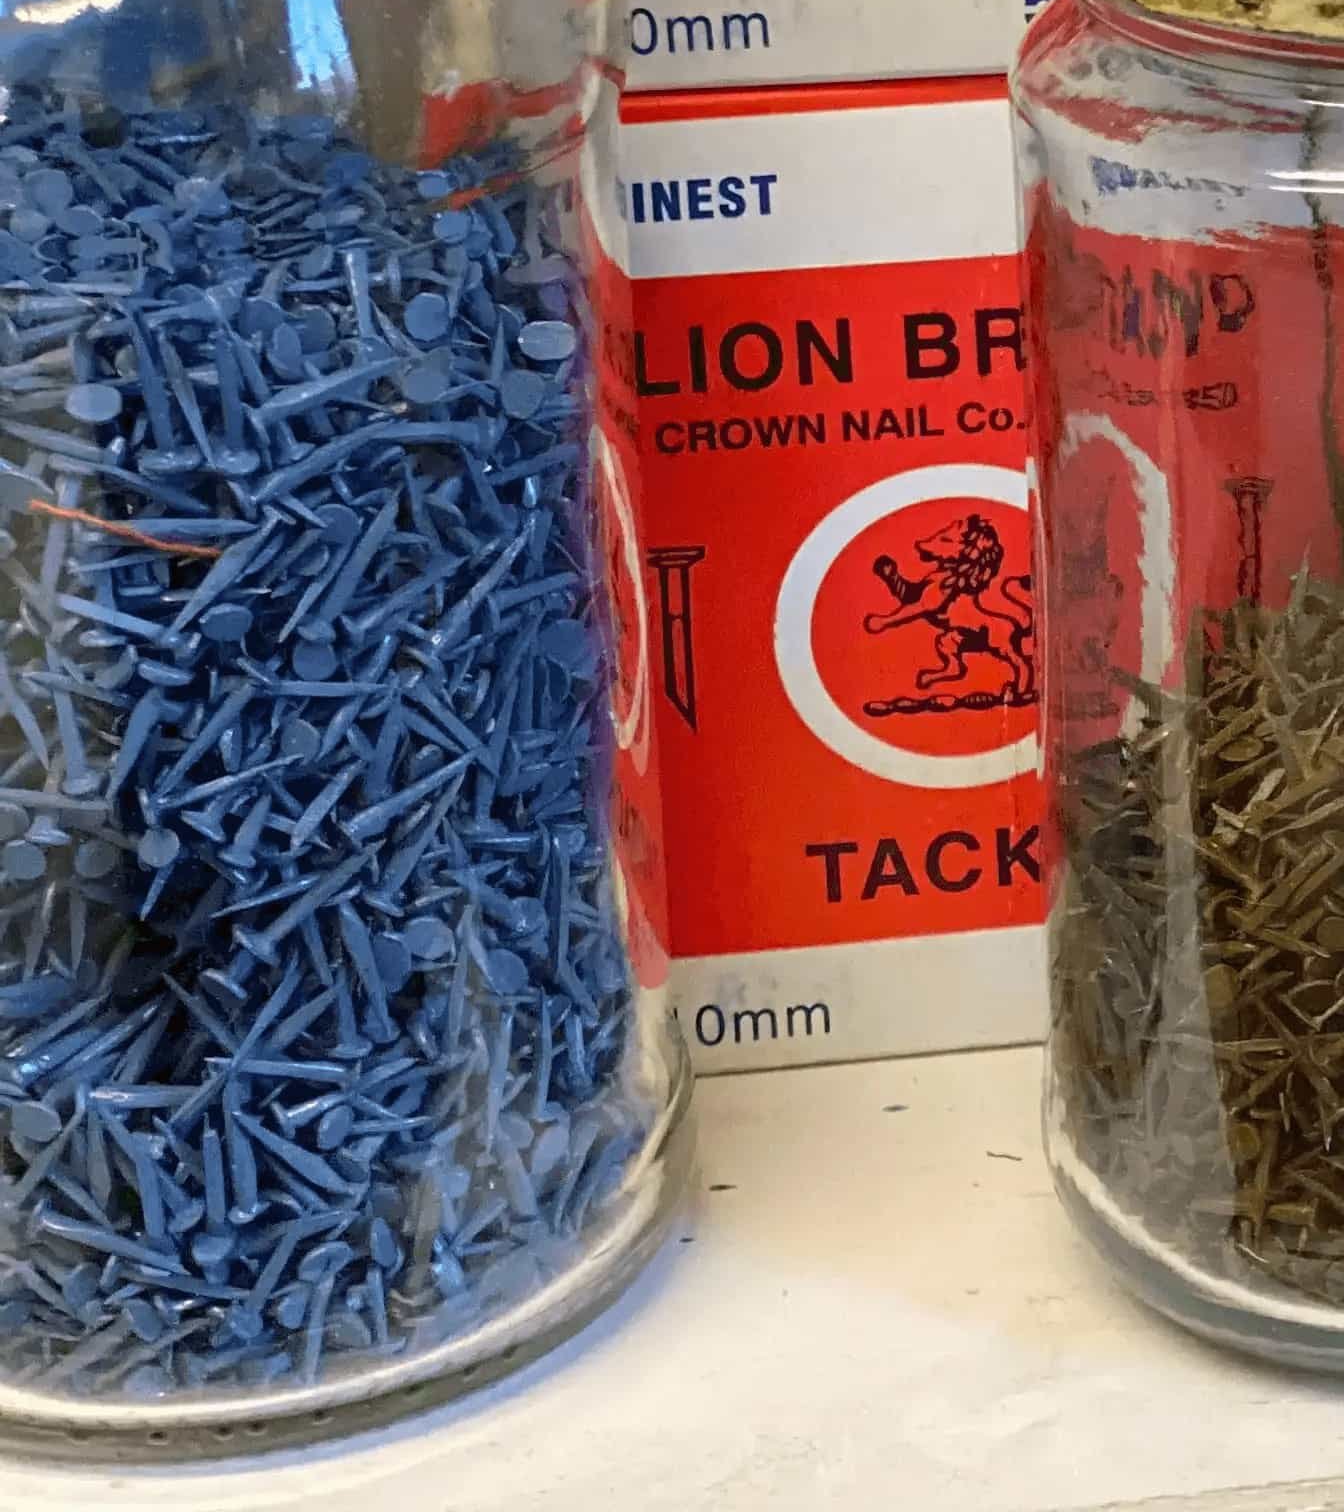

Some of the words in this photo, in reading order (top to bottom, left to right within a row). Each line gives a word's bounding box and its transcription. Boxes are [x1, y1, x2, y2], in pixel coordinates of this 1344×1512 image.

[632, 315, 857, 397] LION
[653, 411, 827, 456] CROWN
[841, 403, 946, 442] NAIL
[955, 400, 1027, 435] Co.
[671, 998, 832, 1048] 0mm
